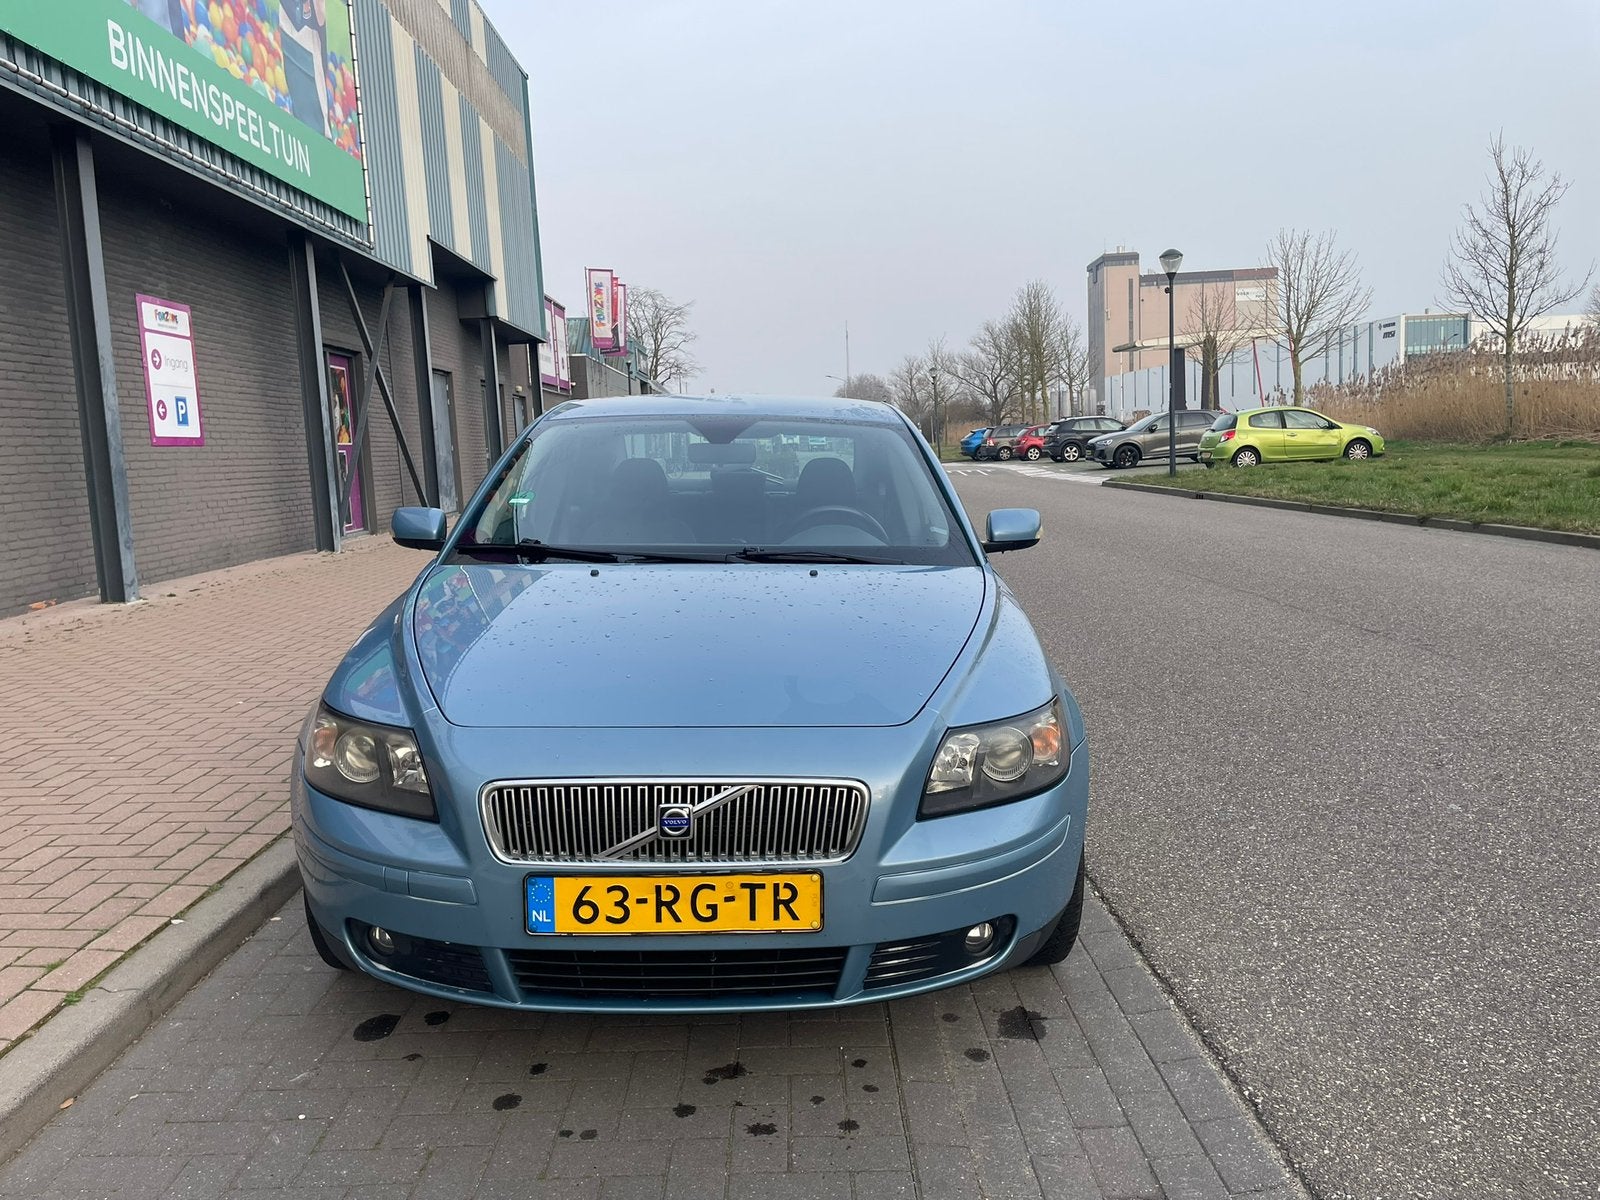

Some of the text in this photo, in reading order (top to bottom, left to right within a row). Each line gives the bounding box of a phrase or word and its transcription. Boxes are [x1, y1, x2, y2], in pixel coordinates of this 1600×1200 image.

[107, 19, 312, 178] BINNENSPEELTUIN
[164, 355, 189, 373] Ingang
[177, 401, 187, 422] P
[571, 882, 801, 925] 63-RG-TR
[532, 909, 552, 923] NL
